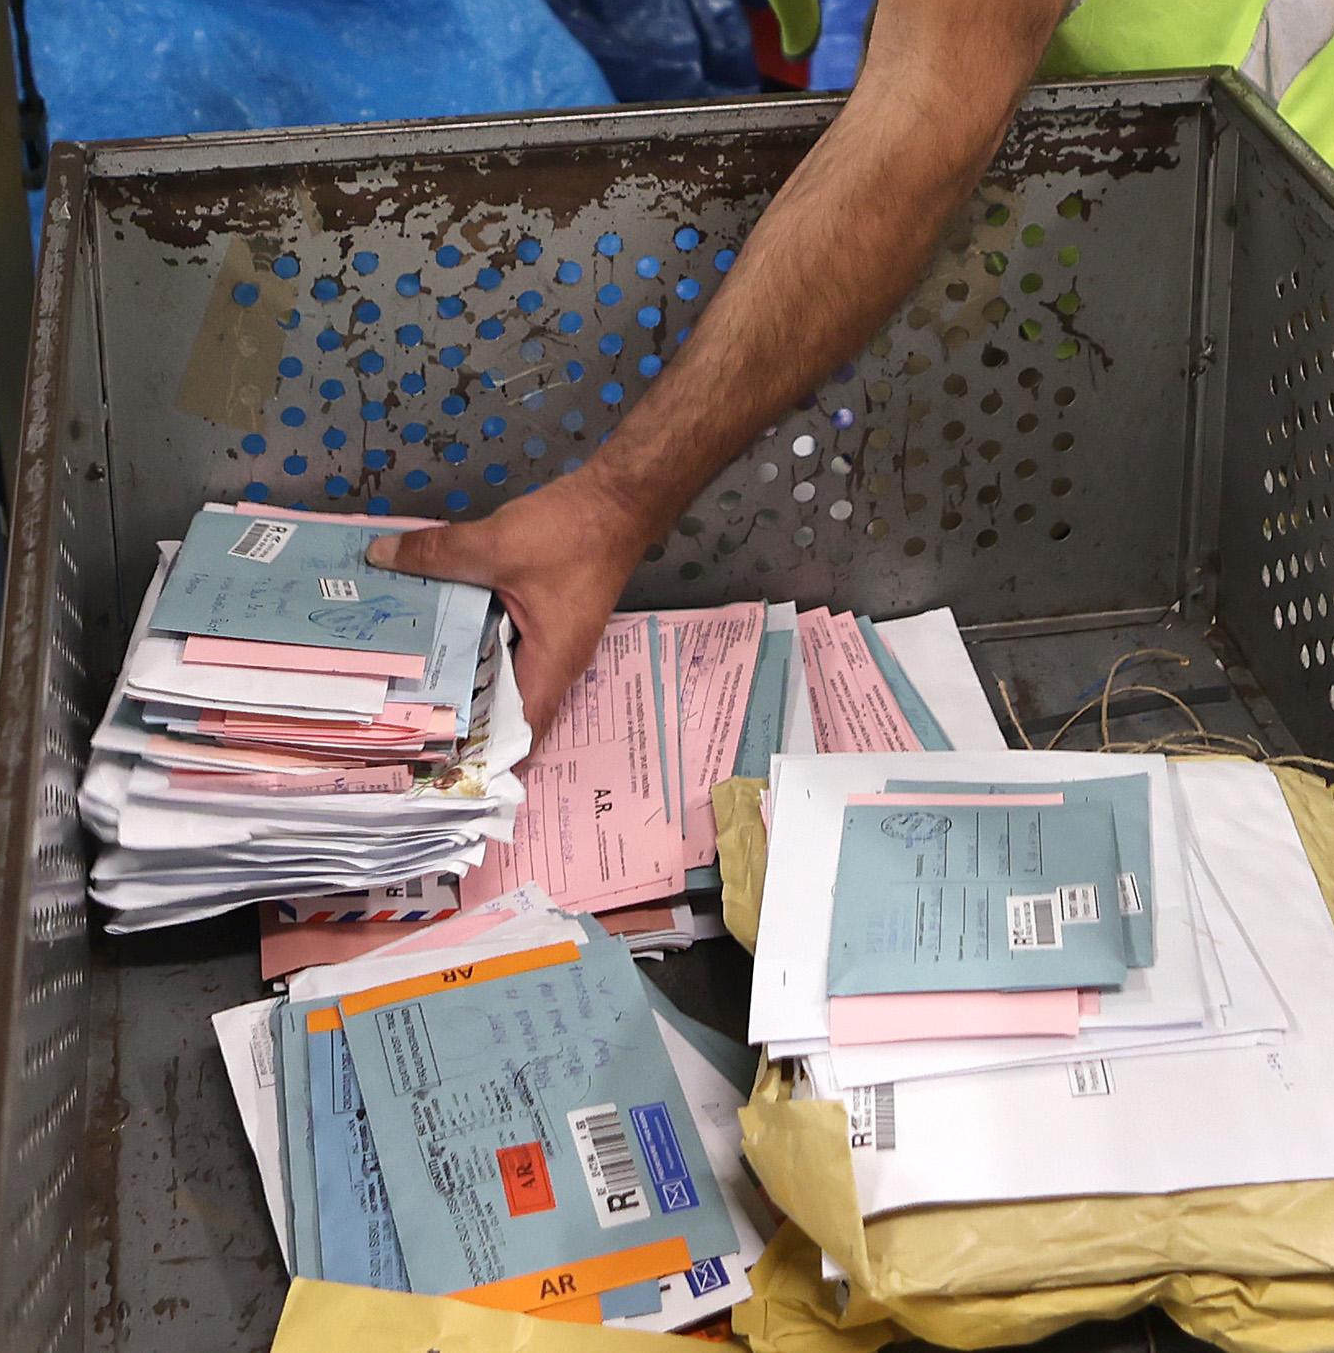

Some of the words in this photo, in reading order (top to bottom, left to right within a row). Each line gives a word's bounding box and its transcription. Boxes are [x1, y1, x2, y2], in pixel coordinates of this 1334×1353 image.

[593, 788, 614, 820] A.R.
[441, 965, 474, 984] AR
[851, 1132, 871, 1148] R
[607, 1188, 639, 1213] R
[539, 1272, 576, 1300] AR
